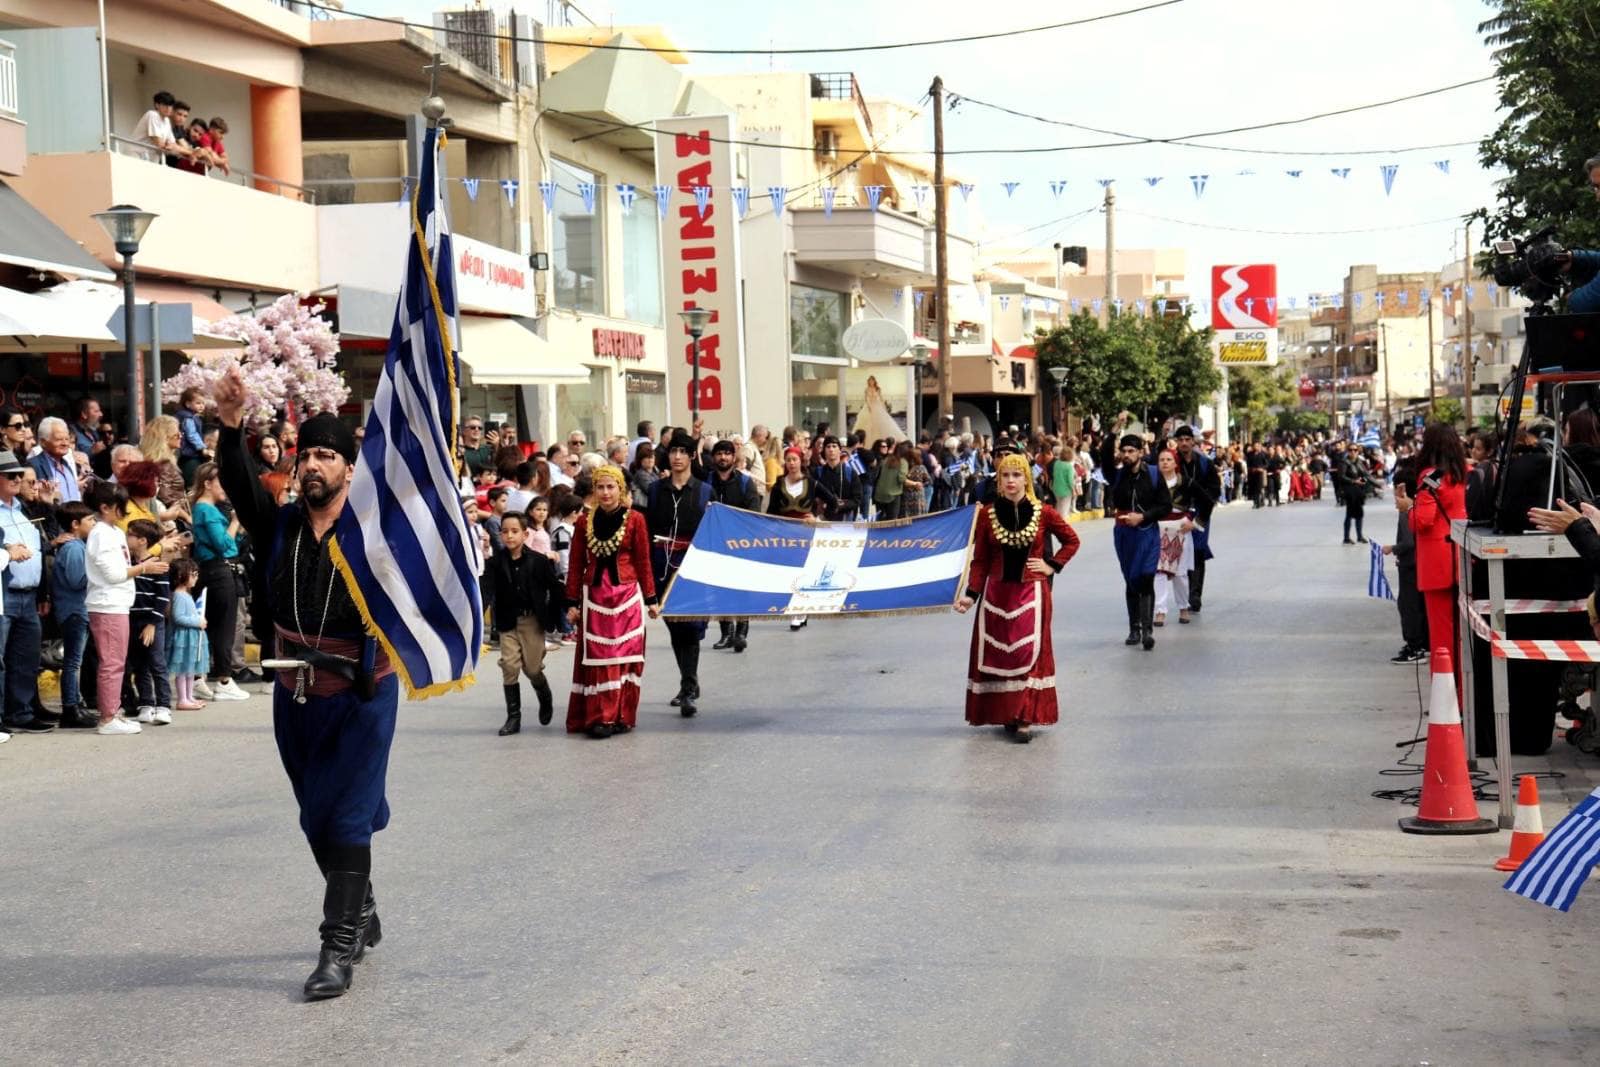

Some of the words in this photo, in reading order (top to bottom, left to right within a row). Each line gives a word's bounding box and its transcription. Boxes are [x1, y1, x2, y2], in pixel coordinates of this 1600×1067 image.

[1235, 331, 1265, 341] EKO
[726, 537, 851, 550] ΠΟΛΙΤΙΣΤΙΚΟΣ
[856, 538, 943, 548] ΣΥΛΛΟΓΟΣ
